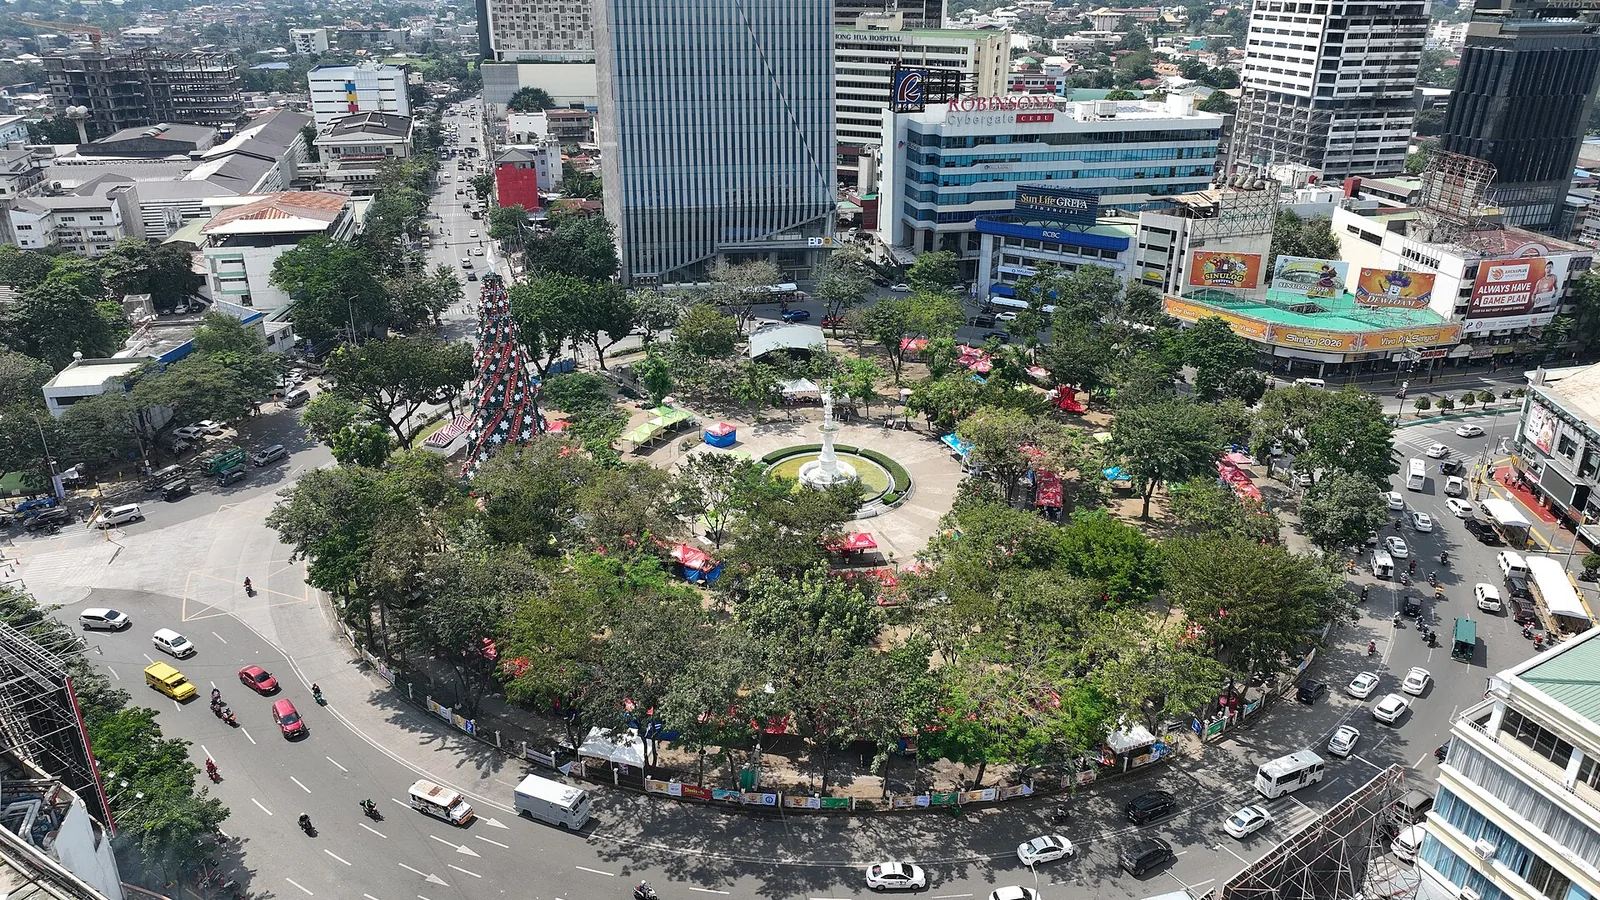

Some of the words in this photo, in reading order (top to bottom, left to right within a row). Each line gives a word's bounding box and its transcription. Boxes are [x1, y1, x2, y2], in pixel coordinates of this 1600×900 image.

[948, 95, 1055, 112] ROBINSONS
[947, 114, 1014, 127] Cybergate
[1021, 193, 1037, 204] Sun
[1038, 195, 1055, 205] Life
[1056, 197, 1088, 209] GREPA
[1029, 204, 1078, 215] Financial
[1042, 230, 1060, 239] RCBC
[808, 237, 832, 246] BDO
[1205, 272, 1244, 281] SINULOG
[1478, 284, 1510, 294] ALWAYS
[1511, 283, 1532, 292] HAVE
[1367, 295, 1416, 306] DEWFOAM
[1482, 297, 1505, 305] GAME
[1507, 294, 1527, 303] PLAN
[1285, 334, 1317, 346] Sinulog
[1319, 338, 1343, 347] 2026
[1381, 336, 1396, 345] Viva
